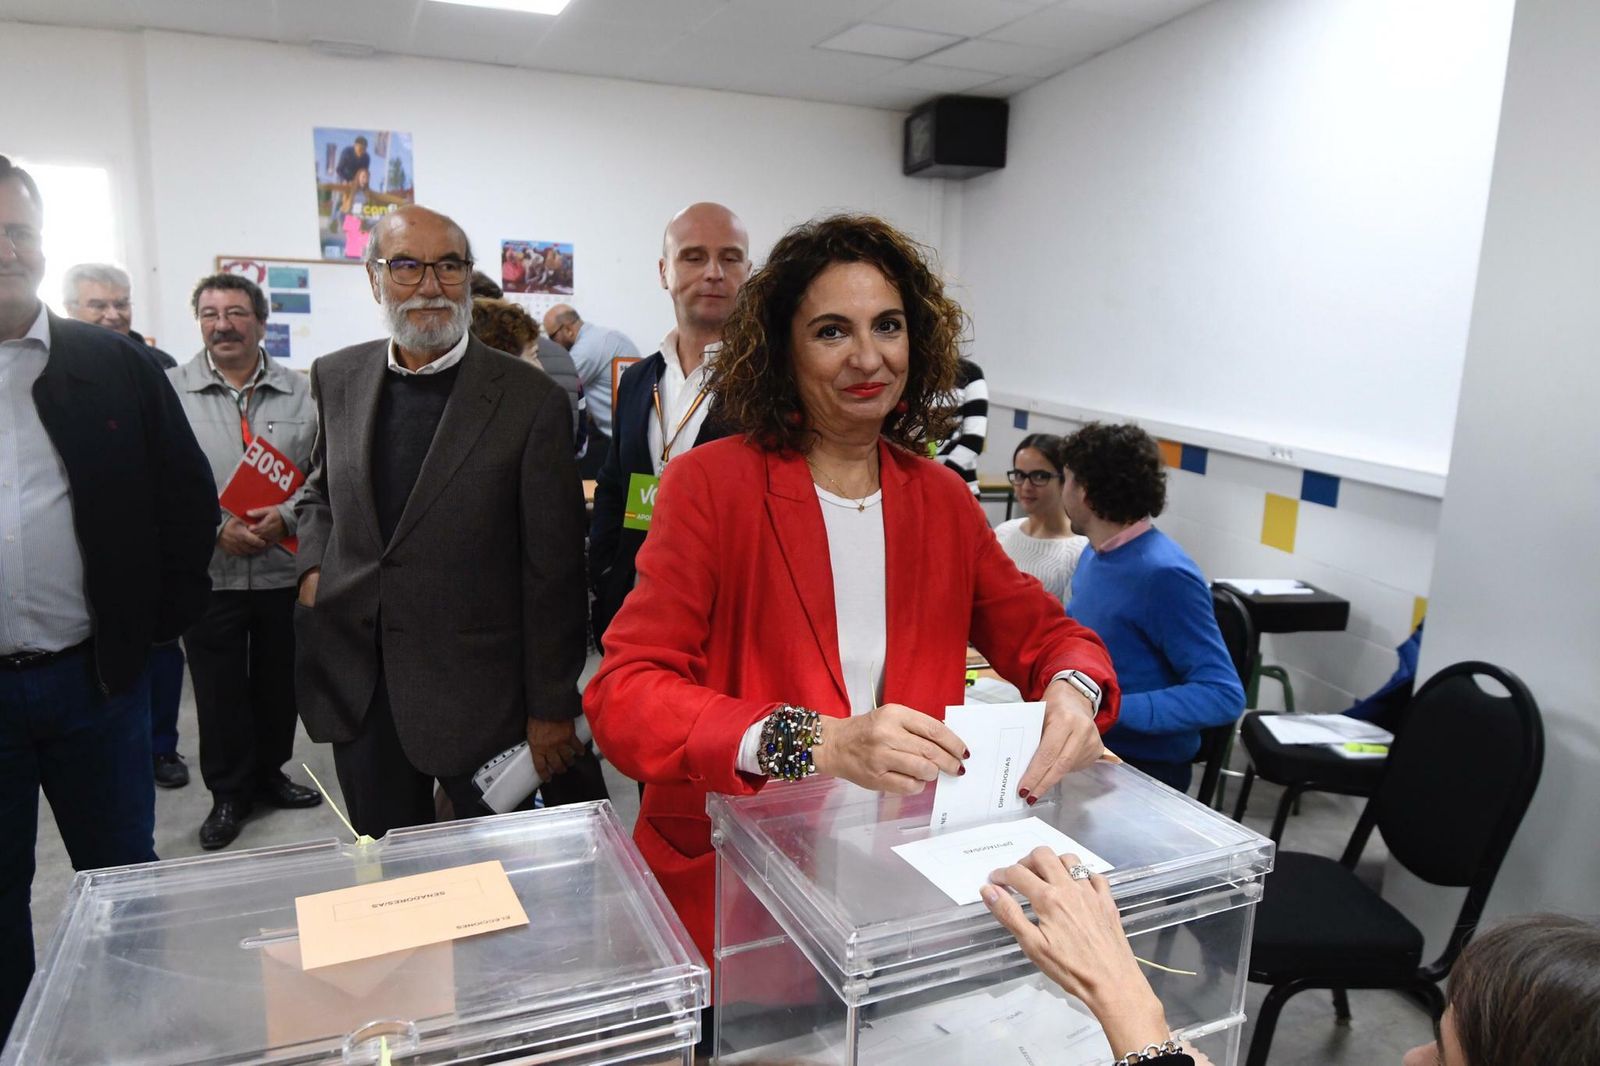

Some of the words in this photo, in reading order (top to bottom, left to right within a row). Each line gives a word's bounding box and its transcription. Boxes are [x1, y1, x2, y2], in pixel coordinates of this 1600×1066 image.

[244, 440, 295, 492] PSOE
[998, 757, 1011, 808] DIPUTADOS/AS
[371, 891, 446, 908] SENADORES/AS
[456, 915, 511, 929] ELECCIONES
